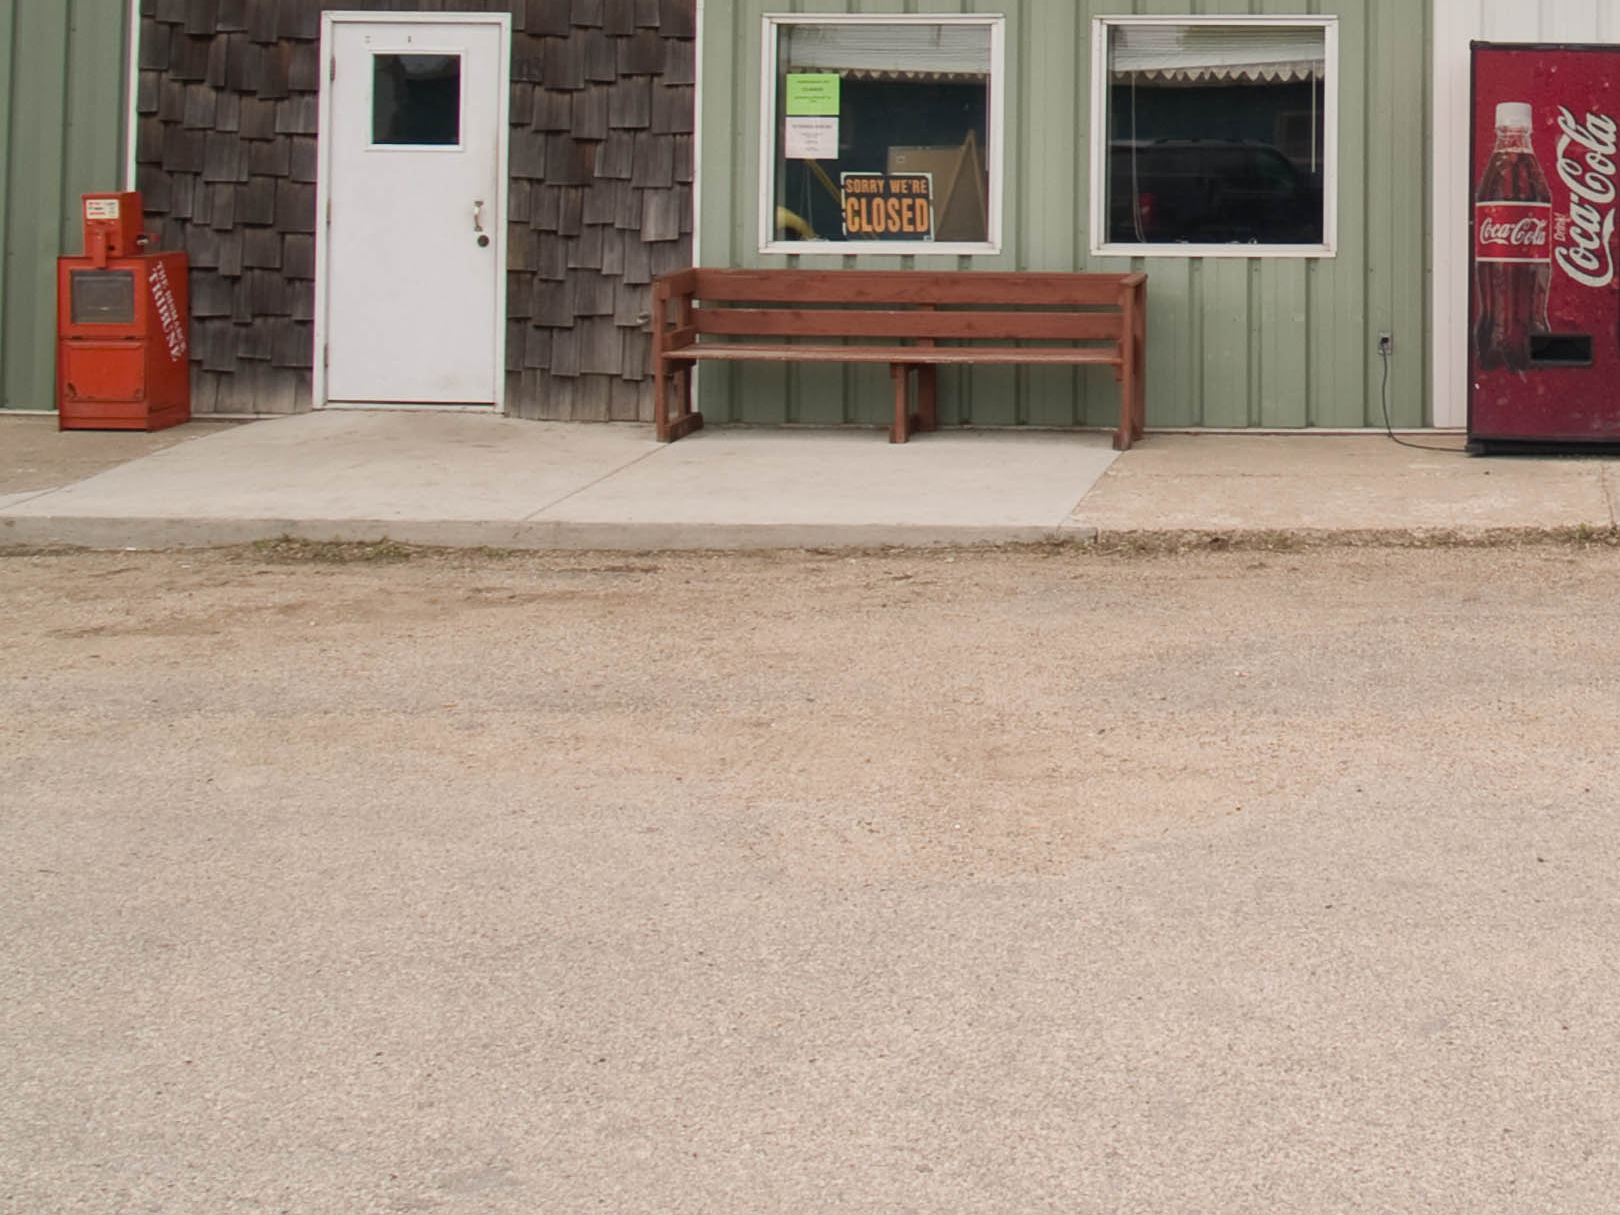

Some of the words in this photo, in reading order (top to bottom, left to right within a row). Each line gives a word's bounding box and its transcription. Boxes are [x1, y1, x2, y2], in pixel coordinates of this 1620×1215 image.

[845, 179, 884, 194] SORRY
[889, 179, 928, 194] WE'RE
[1554, 105, 1617, 287] Coca-Cola
[846, 197, 930, 233] CLOSED
[1480, 217, 1547, 245] Coca-Cola
